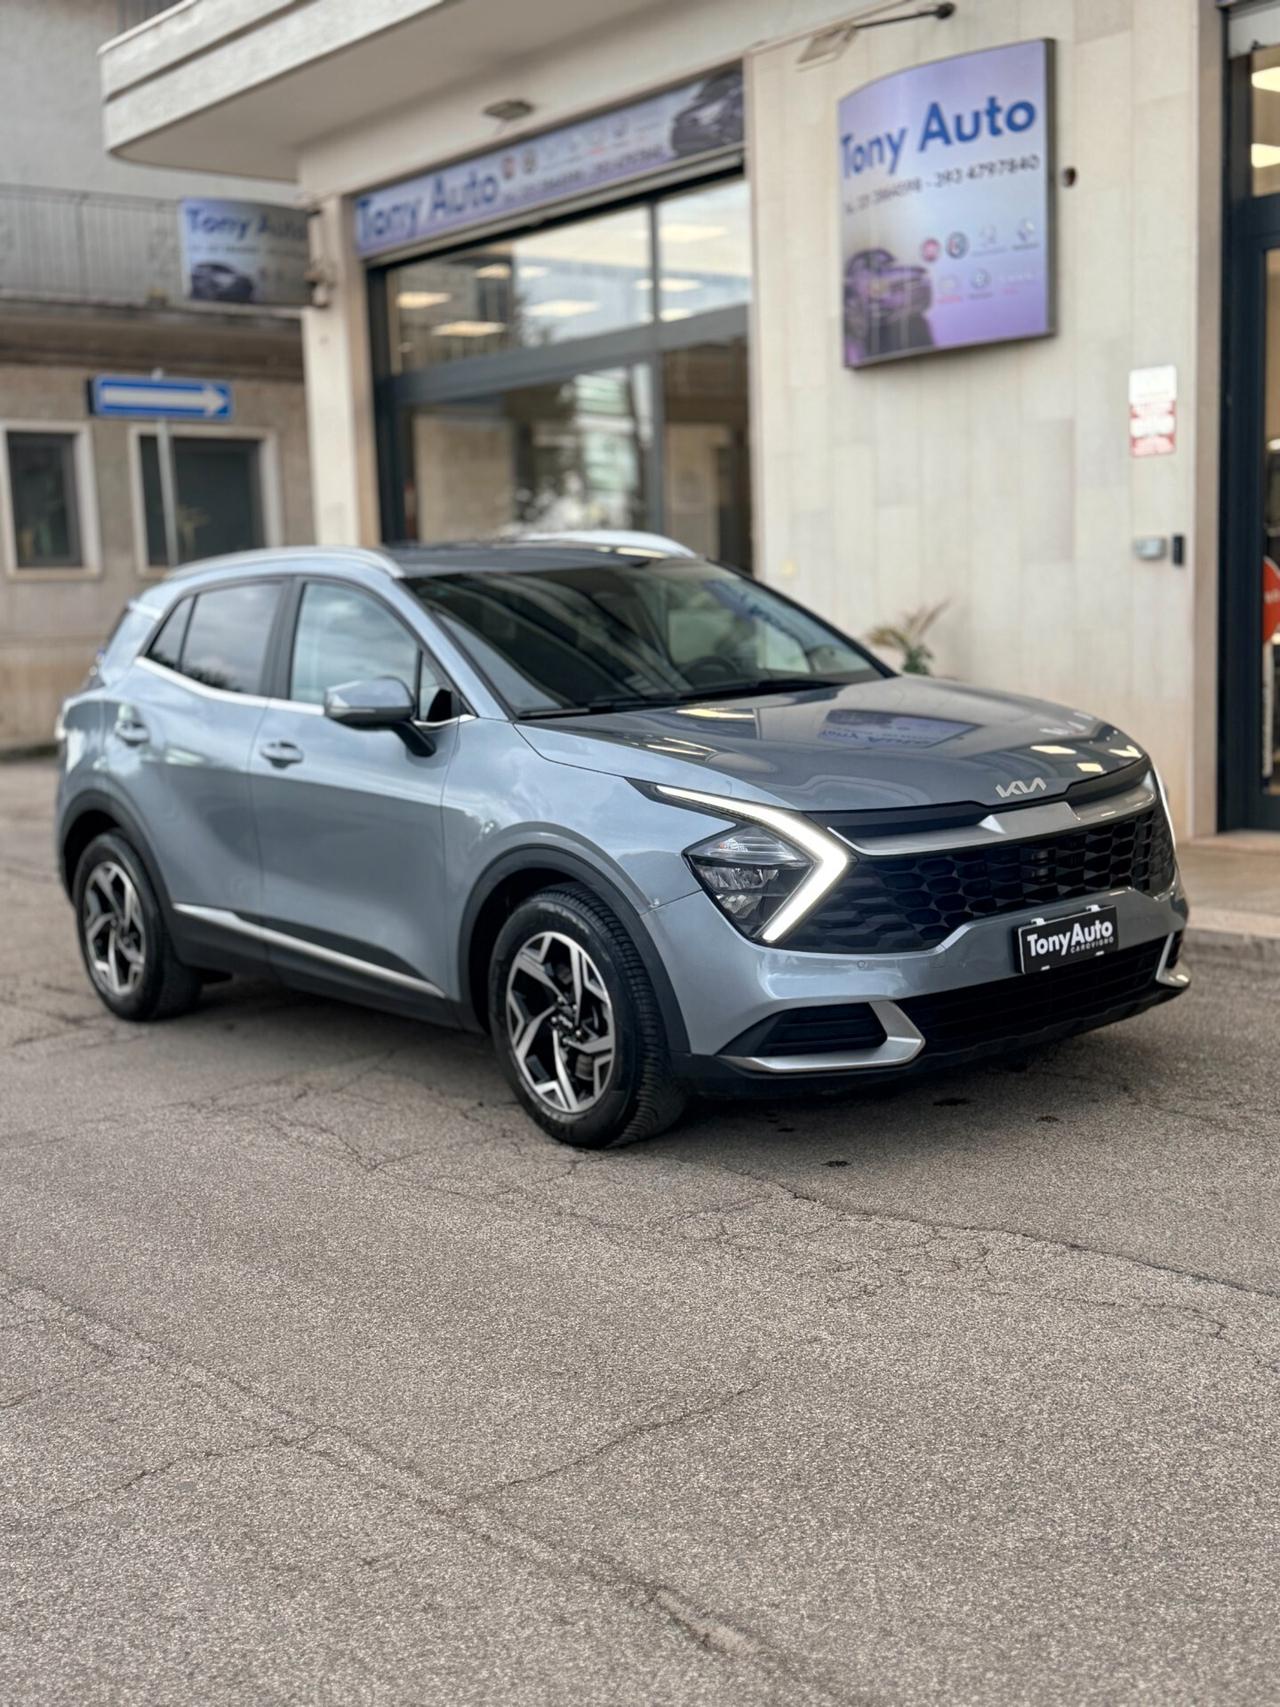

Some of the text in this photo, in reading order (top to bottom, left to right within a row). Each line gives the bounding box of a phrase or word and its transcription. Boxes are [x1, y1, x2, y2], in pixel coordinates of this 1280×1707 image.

[841, 96, 1036, 179] Tony Auto
[186, 206, 251, 240] Tony
[356, 197, 424, 241] Tony
[430, 171, 498, 220] Auto
[995, 777, 1046, 798] KIA
